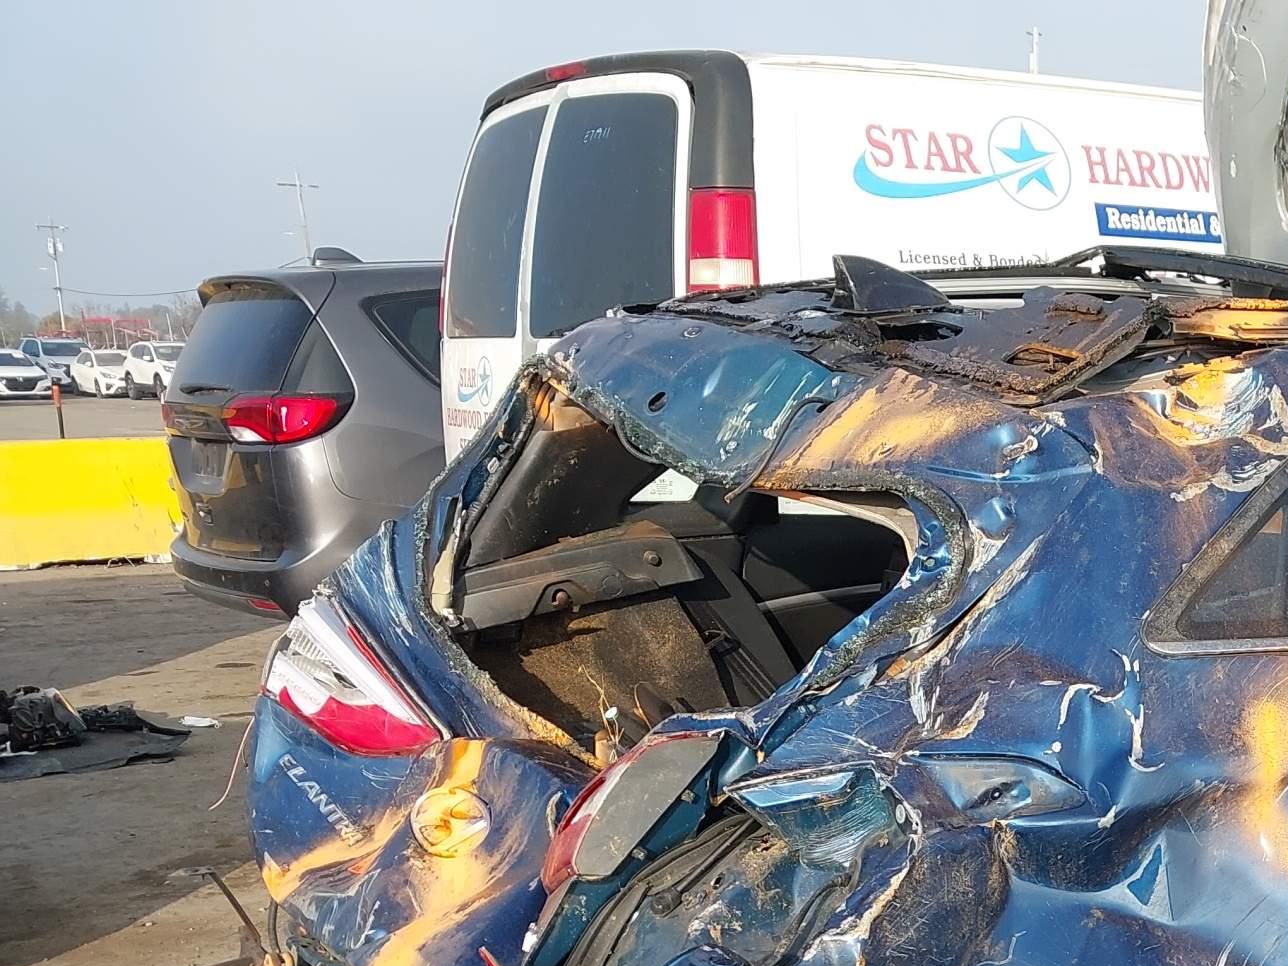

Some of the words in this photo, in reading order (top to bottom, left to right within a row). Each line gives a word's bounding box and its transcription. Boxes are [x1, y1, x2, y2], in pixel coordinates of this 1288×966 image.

[864, 124, 982, 175] STAR
[1081, 145, 1211, 194] HARDW
[1105, 207, 1206, 236] Residential
[898, 249, 968, 266] Licensed
[972, 252, 983, 267] &
[459, 367, 477, 388] STAR
[278, 752, 363, 848] ELANTRA
